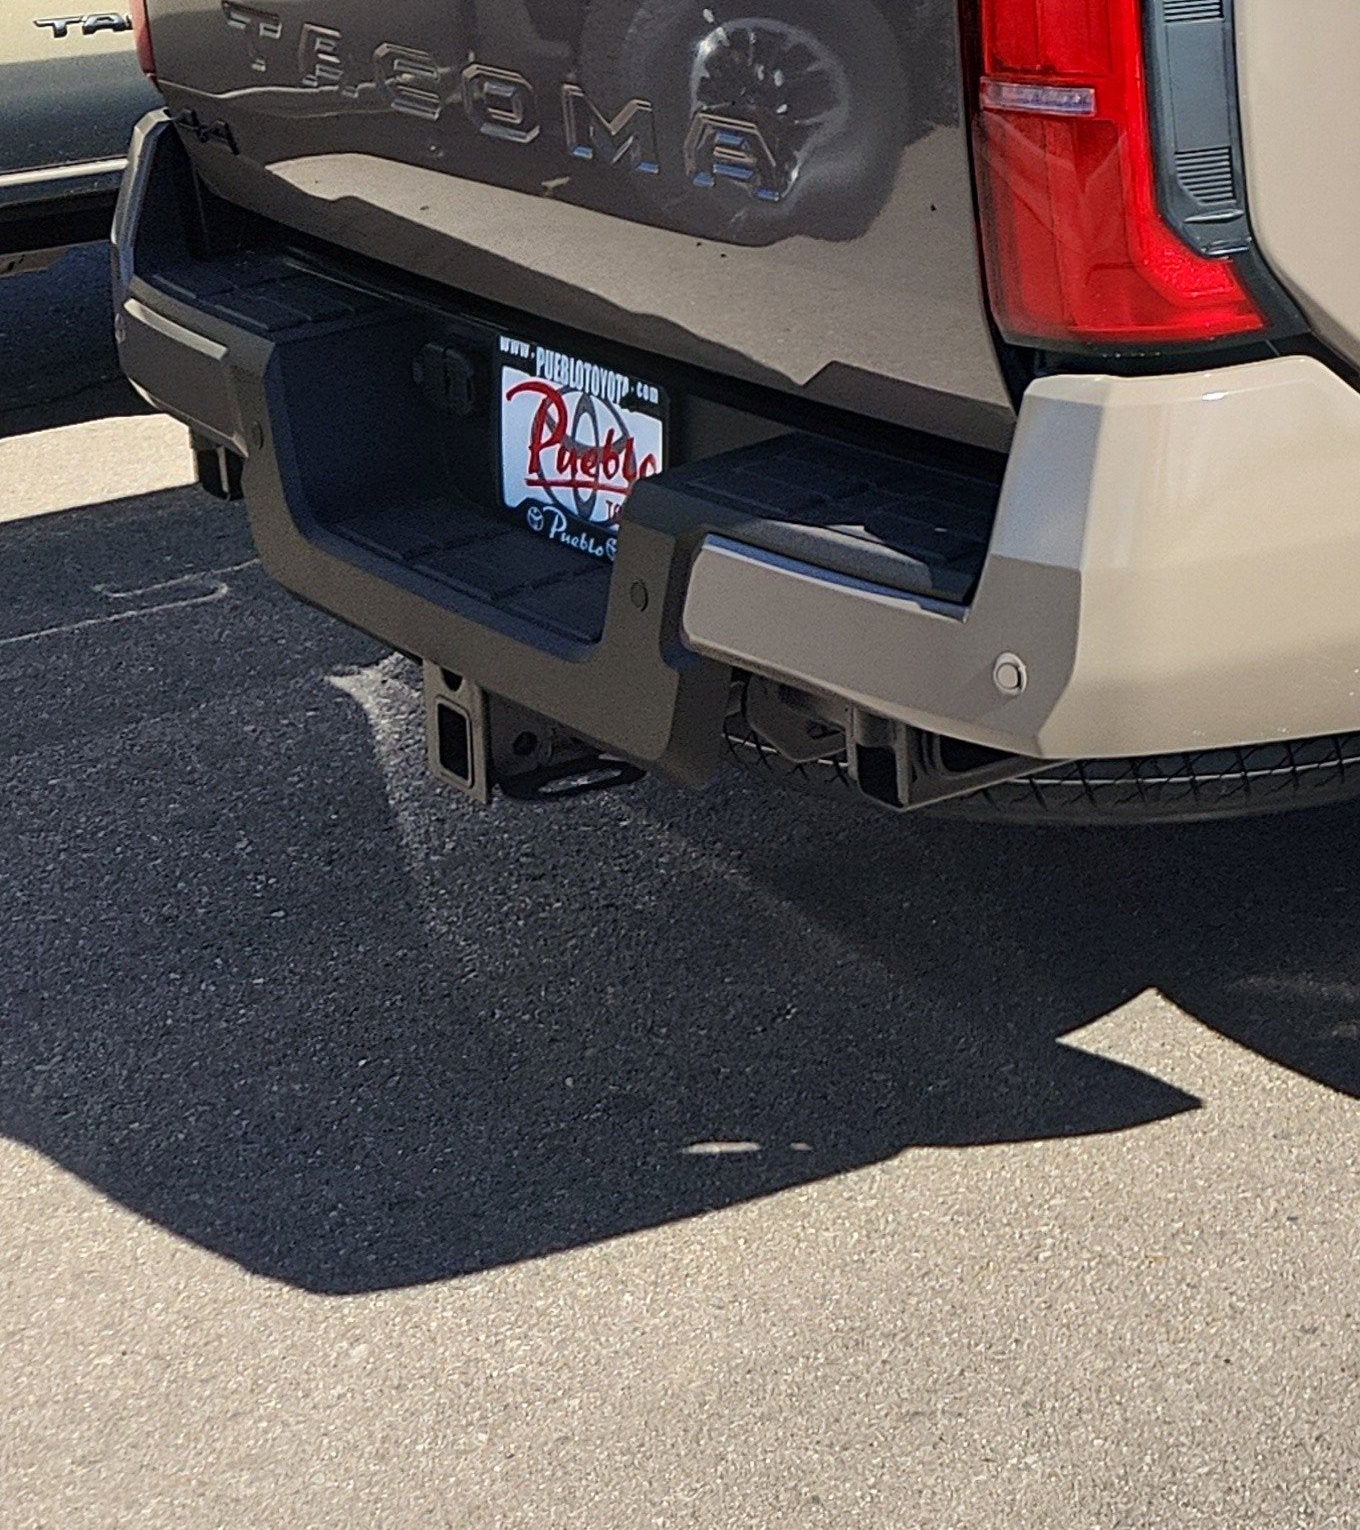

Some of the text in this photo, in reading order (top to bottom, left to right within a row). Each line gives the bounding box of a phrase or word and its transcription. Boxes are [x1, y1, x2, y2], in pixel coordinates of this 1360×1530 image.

[221, 0, 781, 201] TACOMA
[505, 381, 657, 481] Pueblo
[543, 506, 604, 557] Pueblo
